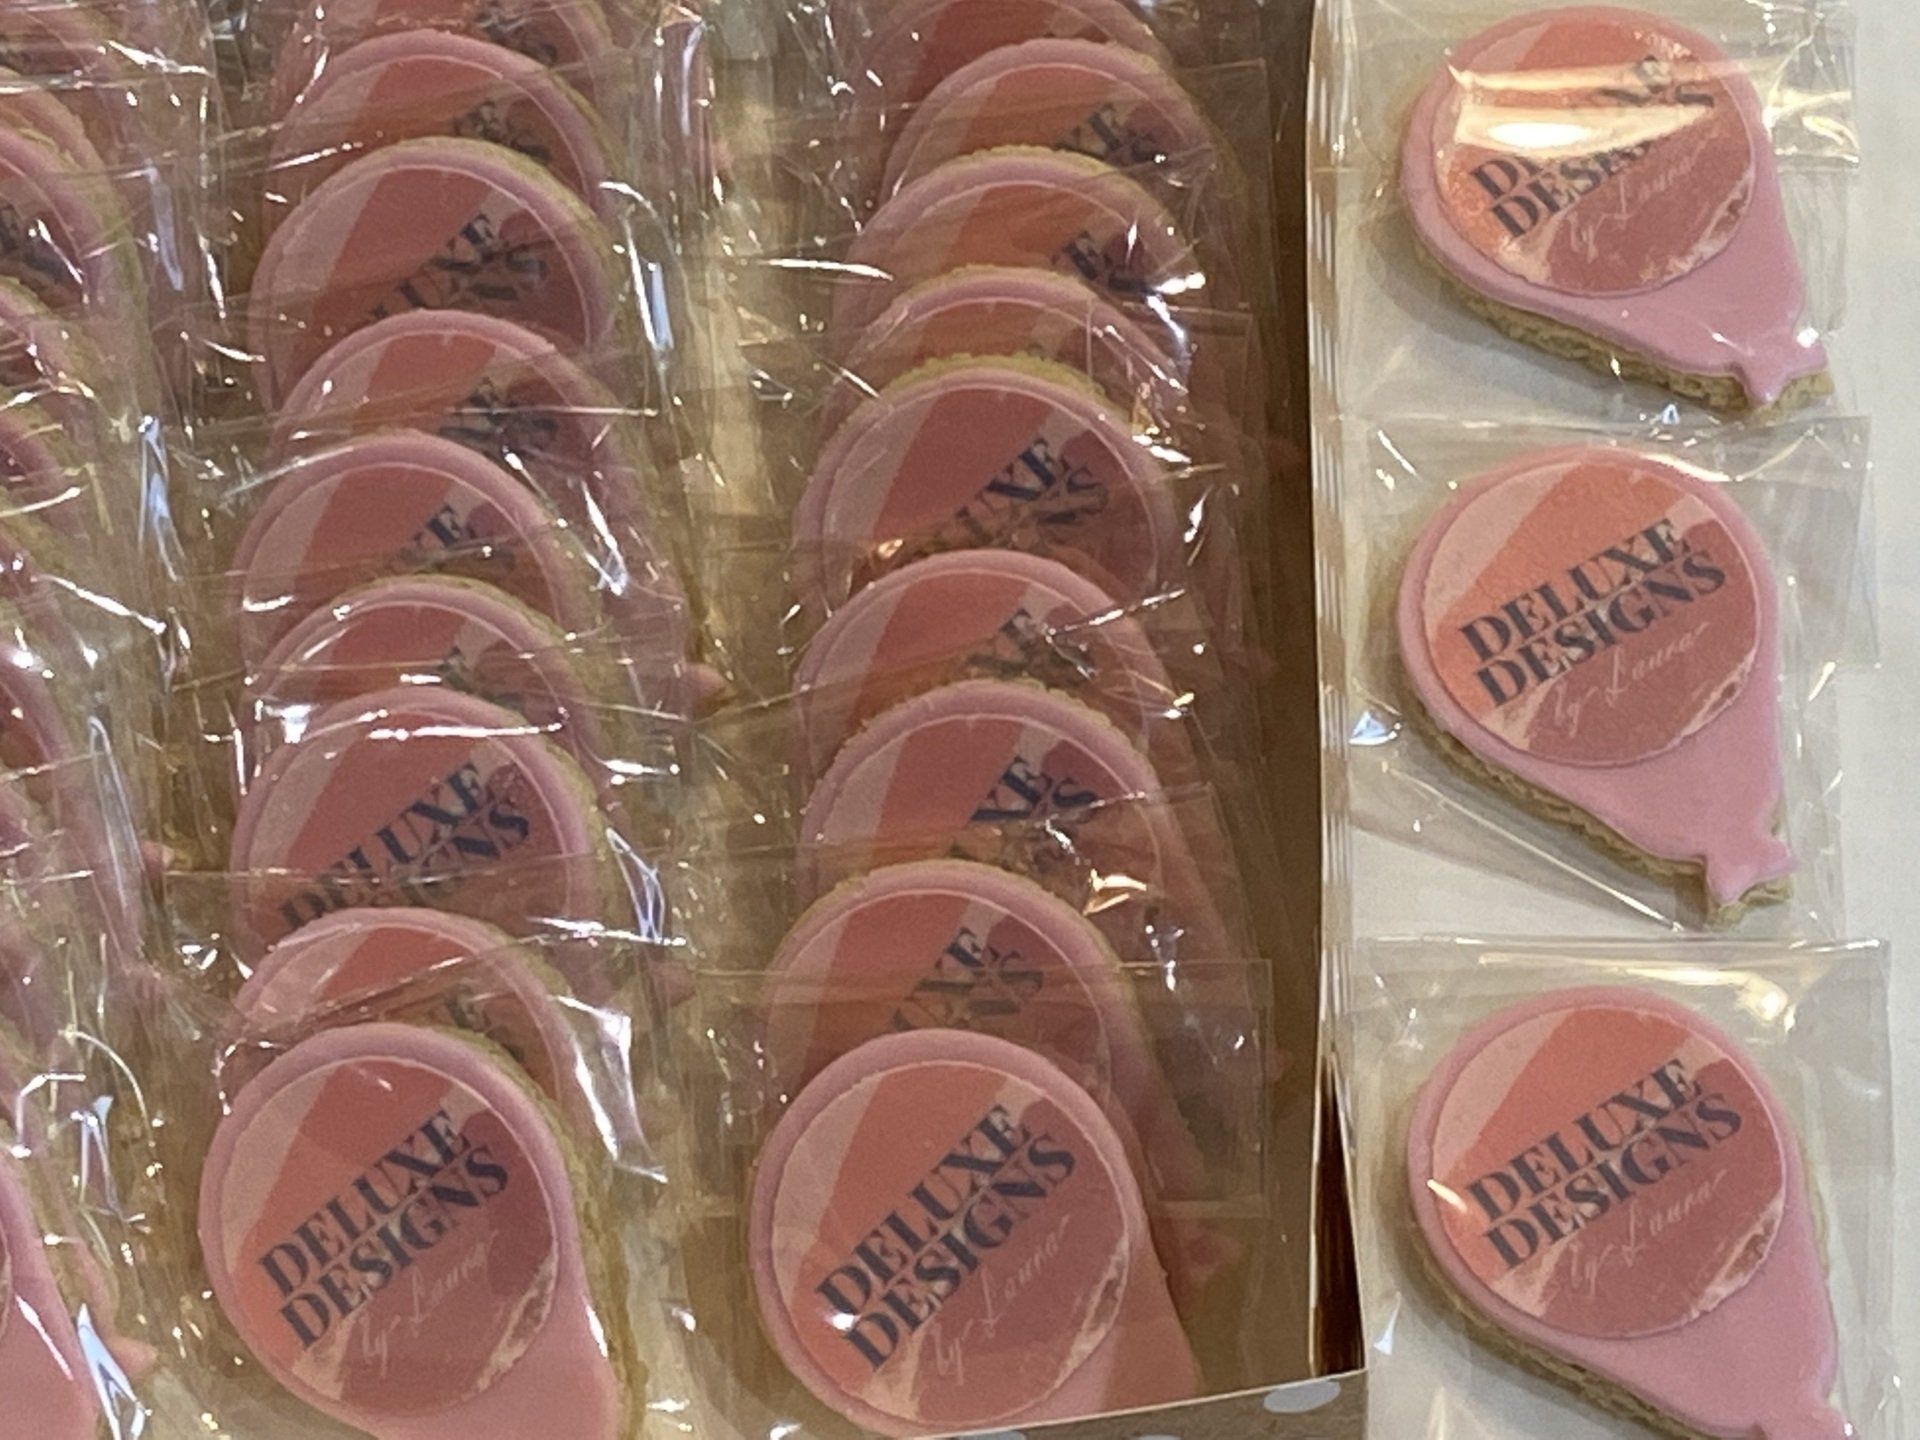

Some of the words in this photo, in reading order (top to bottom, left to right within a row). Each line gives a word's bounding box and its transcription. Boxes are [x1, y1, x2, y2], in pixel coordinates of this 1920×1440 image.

[1458, 517, 1692, 664] DELUXE
[1476, 549, 1727, 708] DESIGNS
[256, 1108, 472, 1300] DELUXE
[814, 1103, 1031, 1319] DELUXE
[1464, 1058, 1704, 1223] DELUXE
[1482, 1092, 1743, 1269] DESIGNS
[278, 1142, 510, 1350] DESIGNS
[842, 1134, 1077, 1372] DESIGNS
